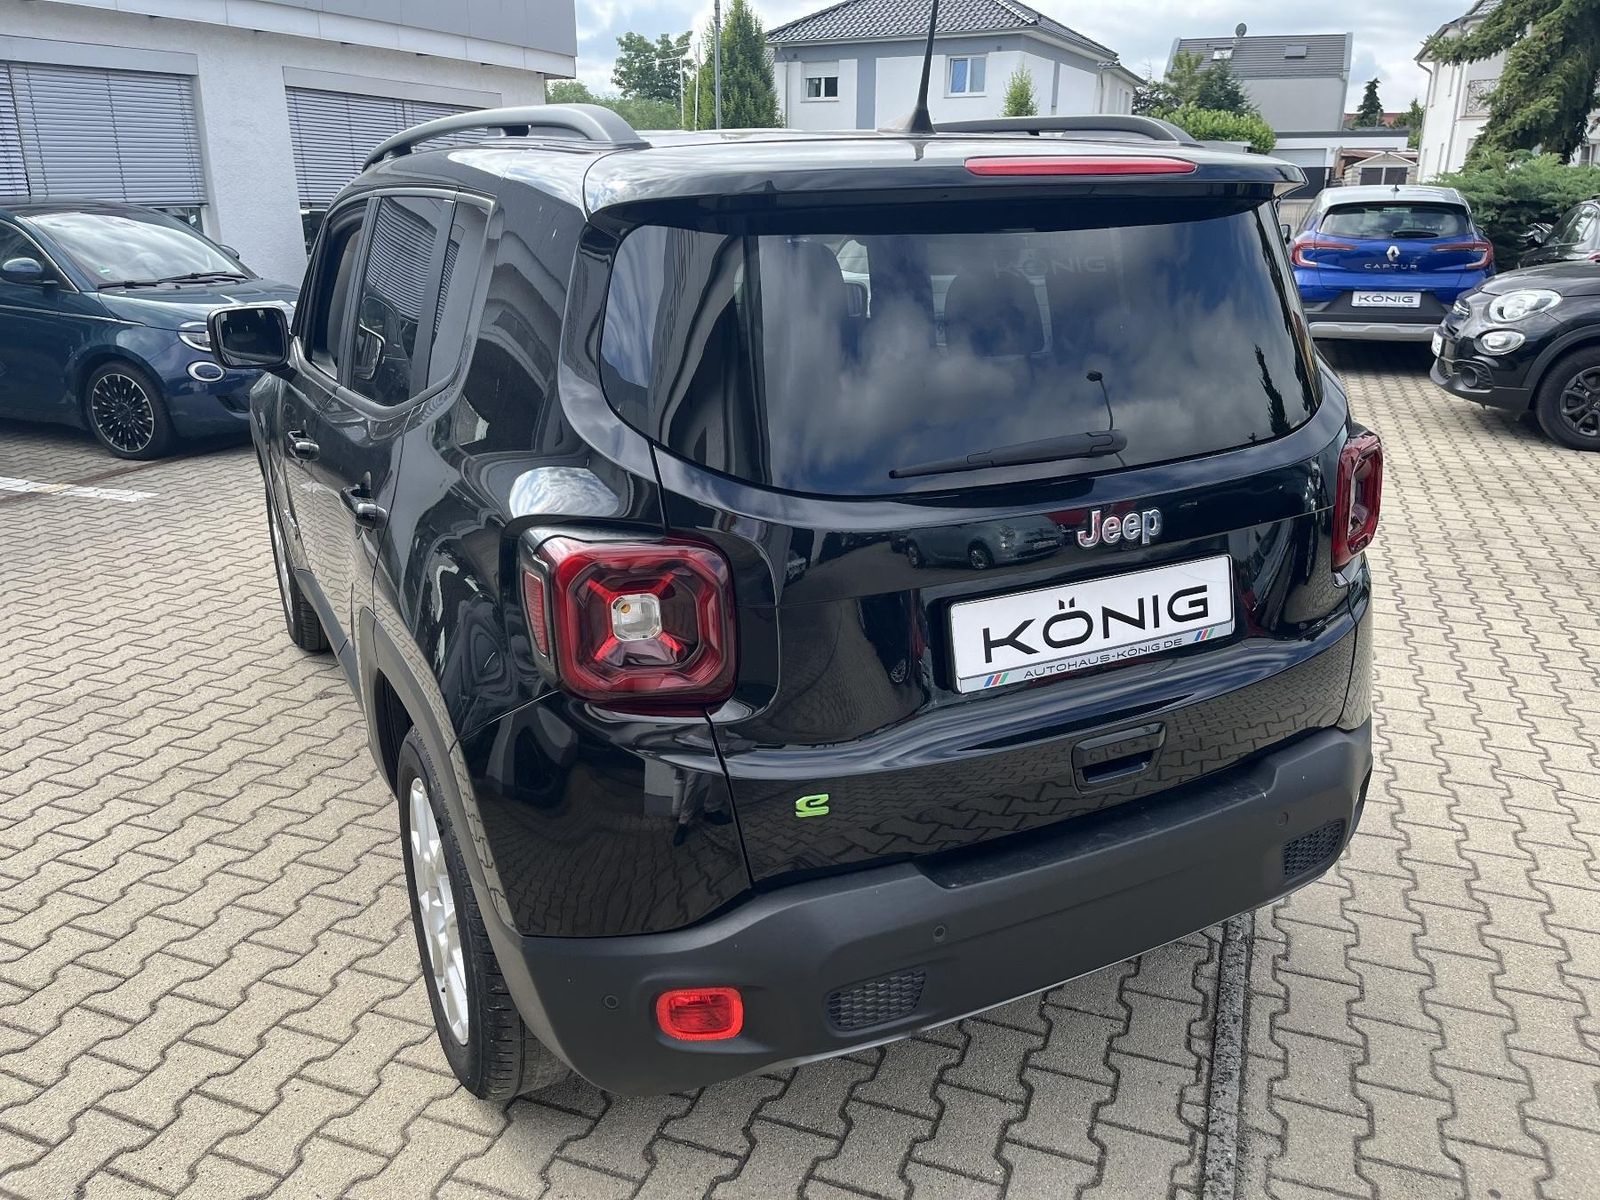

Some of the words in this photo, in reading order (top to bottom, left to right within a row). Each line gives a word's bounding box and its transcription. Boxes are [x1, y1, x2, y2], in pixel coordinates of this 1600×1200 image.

[1358, 293, 1414, 304] KÖNIG
[1076, 507, 1162, 549] Jeep
[982, 584, 1209, 664] KÖNIG
